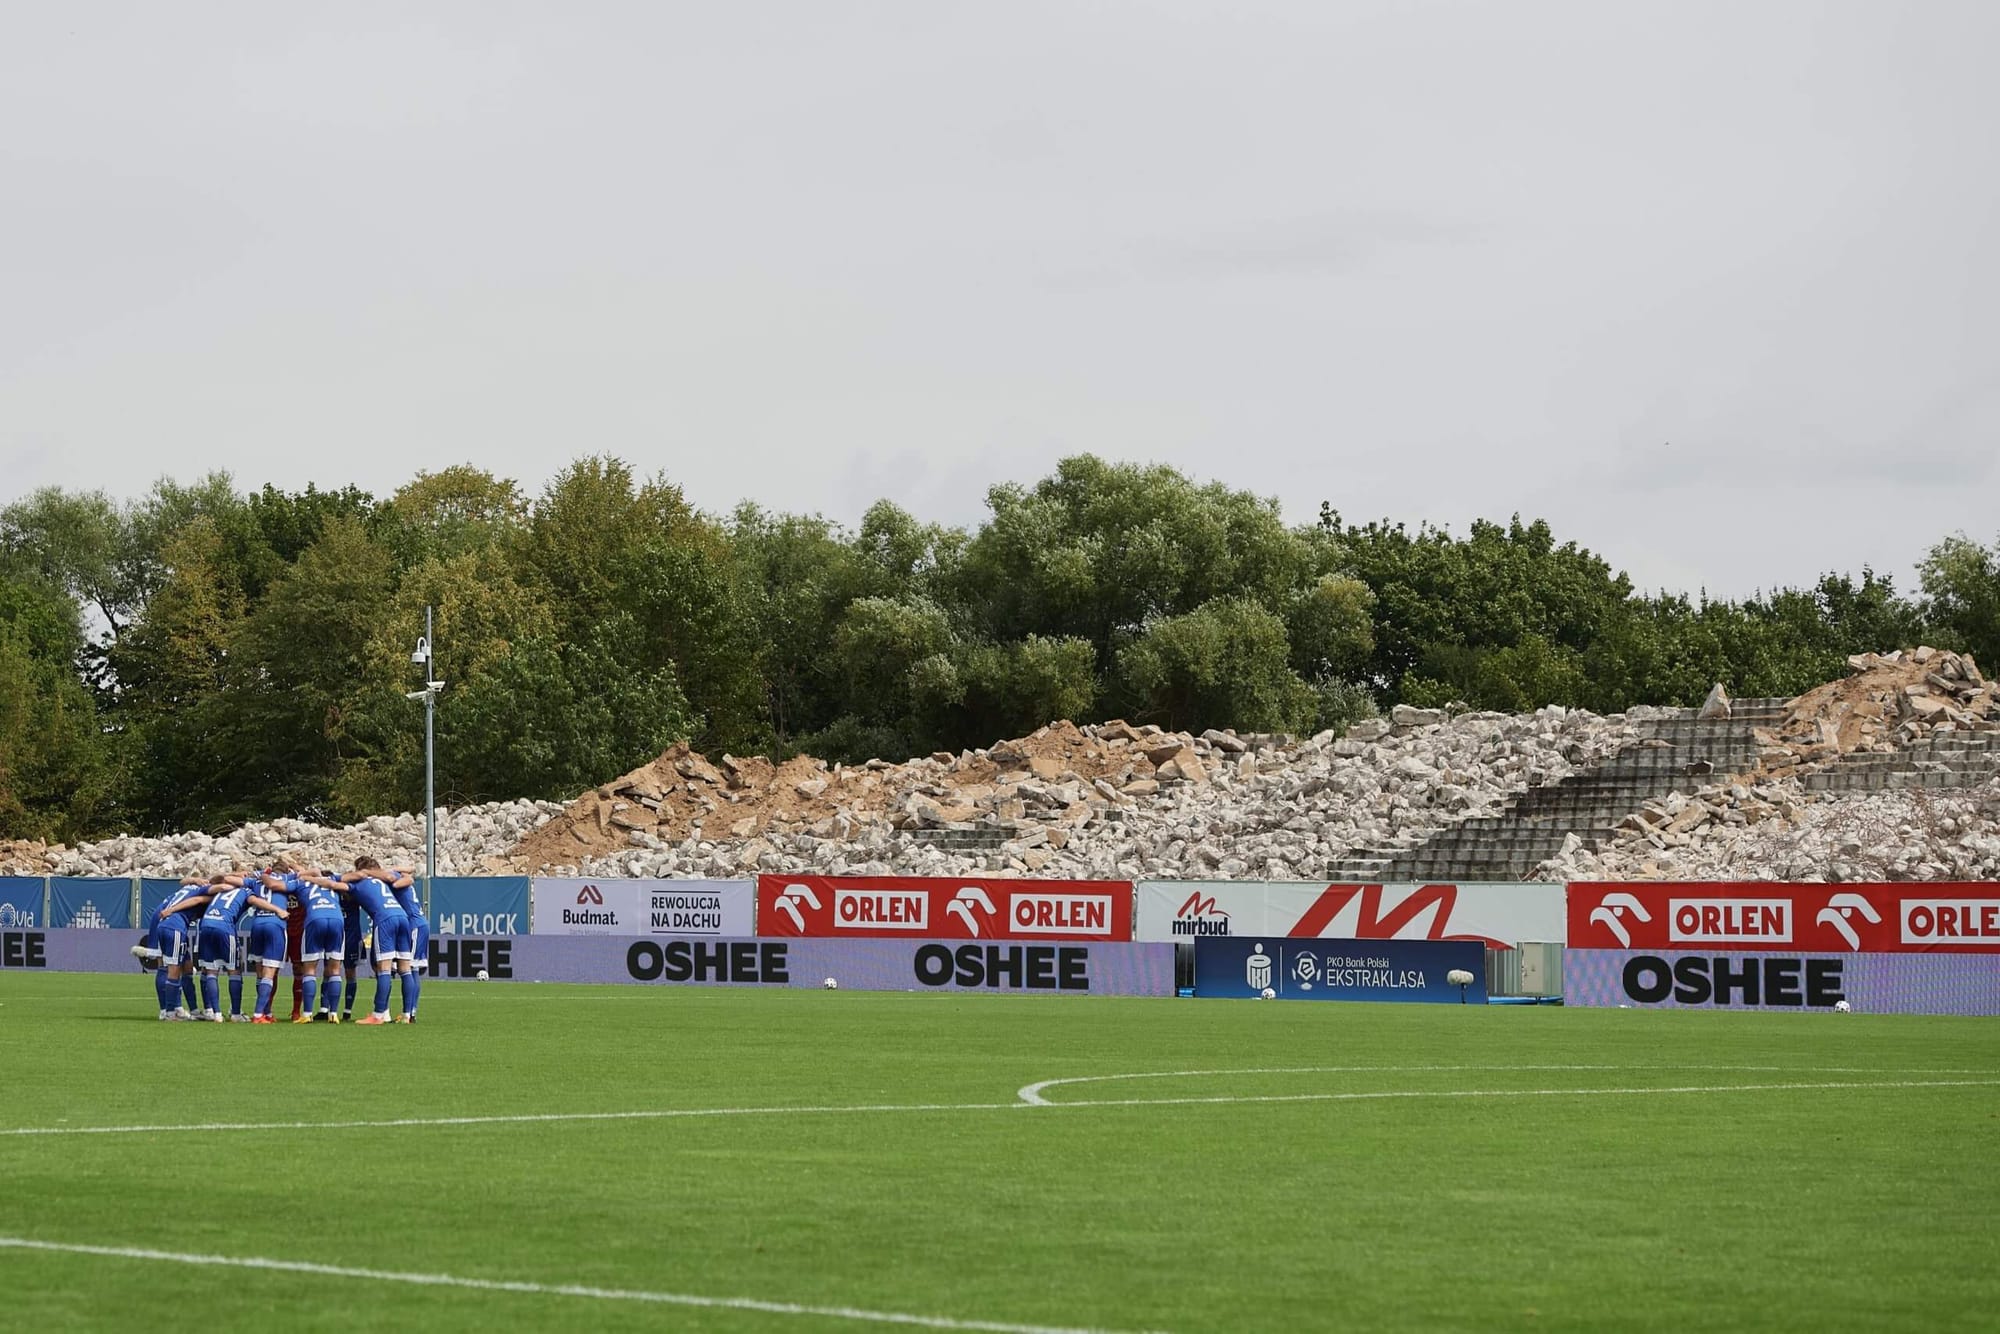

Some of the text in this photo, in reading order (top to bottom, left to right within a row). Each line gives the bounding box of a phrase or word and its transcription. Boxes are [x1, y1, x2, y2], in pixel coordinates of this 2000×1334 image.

[563, 909, 619, 926] Budmat.
[652, 896, 721, 910] REWOLUCJA
[840, 895, 922, 924] ORLEN
[1015, 899, 1105, 929] ORLEN
[462, 913, 518, 935] PŁOCK
[651, 913, 721, 928] NA DACHU
[1172, 917, 1228, 936] mirbud
[1675, 904, 1785, 936] ORLEN
[0, 933, 46, 967] EE
[420, 939, 512, 978] HEE
[627, 941, 789, 983] OSHEE
[1327, 957, 1390, 969] PKO Bank Polski
[914, 944, 1089, 990] OSHEE
[1327, 970, 1426, 989] EKSTRAKLASA
[1622, 954, 1846, 1006] OSHEE
